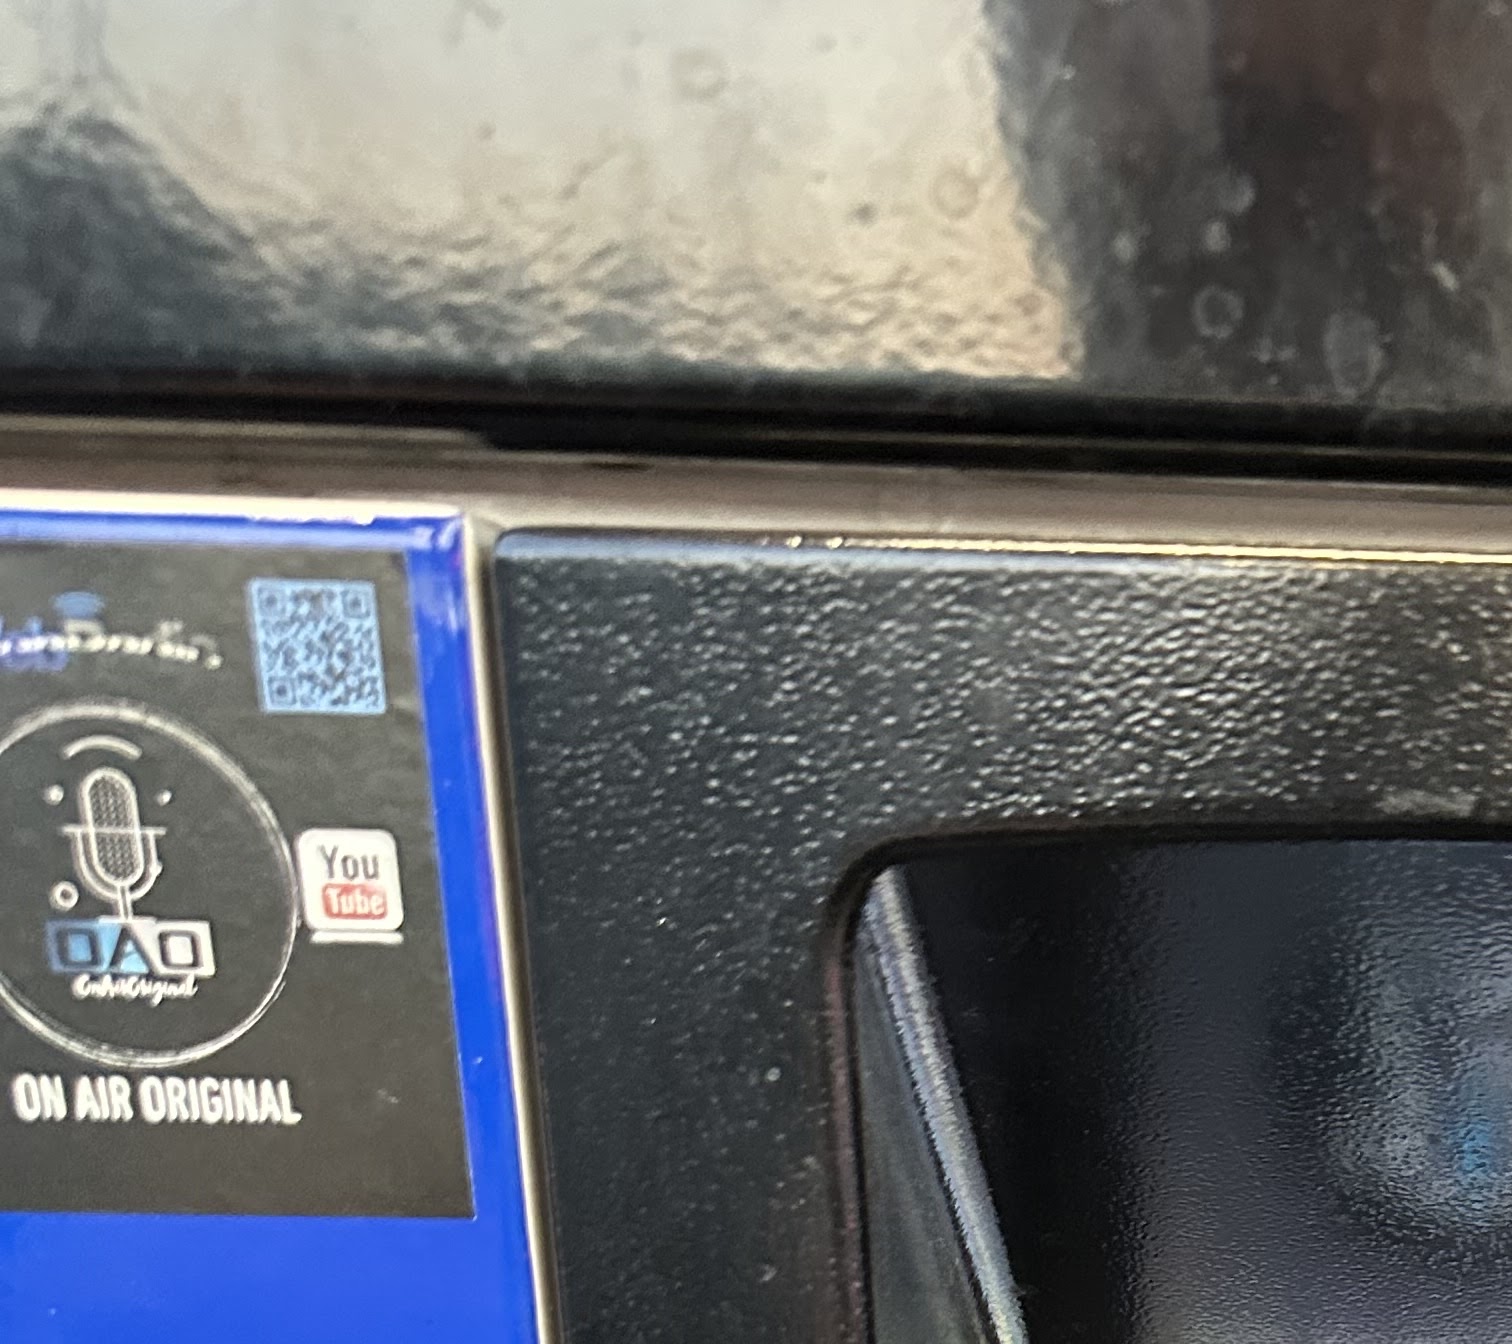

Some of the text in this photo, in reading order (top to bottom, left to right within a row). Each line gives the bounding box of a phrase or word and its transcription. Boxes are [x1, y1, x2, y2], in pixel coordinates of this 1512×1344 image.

[317, 844, 379, 880] You
[324, 887, 386, 916] Tube
[13, 1073, 302, 1125] ON AIR ORIGINAL
